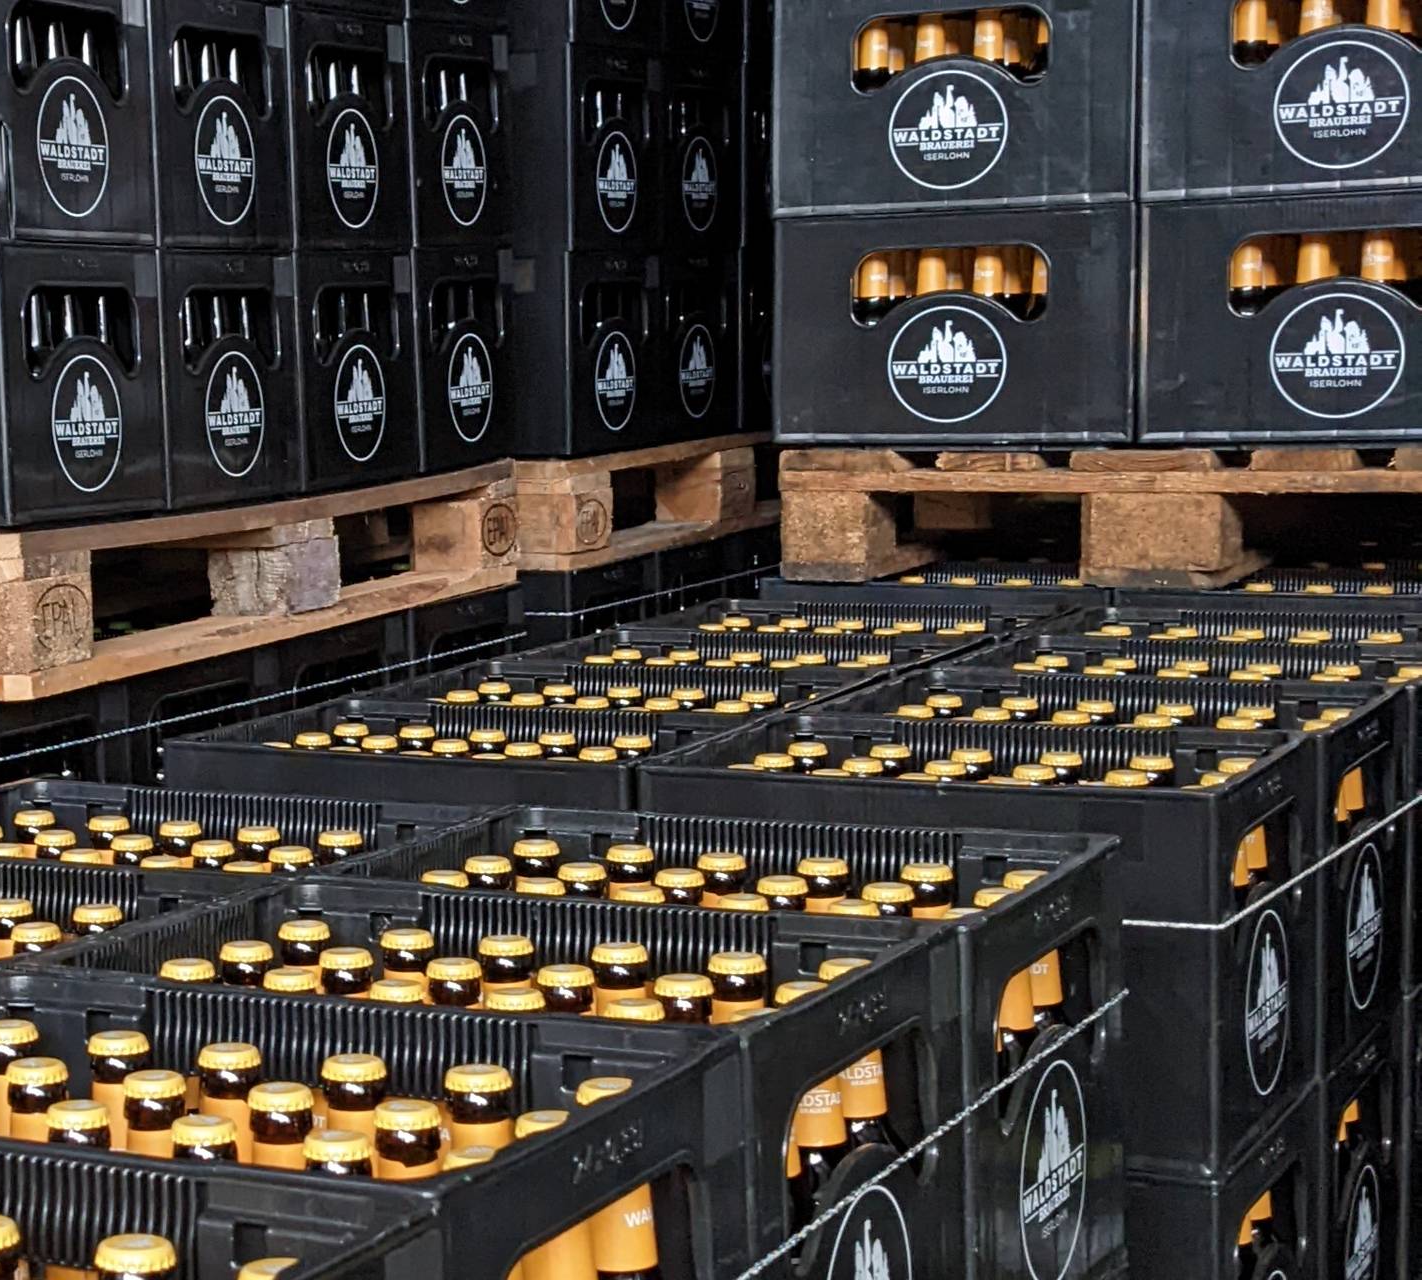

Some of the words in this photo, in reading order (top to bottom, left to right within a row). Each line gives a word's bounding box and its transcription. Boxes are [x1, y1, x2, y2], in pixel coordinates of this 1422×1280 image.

[1279, 100, 1399, 119] WALDSTADT
[1308, 114, 1372, 127] BRAUEREI
[893, 127, 1000, 143] WALDSTADT
[1314, 128, 1366, 139] ISERLOHN
[919, 139, 975, 151] BRAUEREI
[40, 143, 104, 161] WALDSTADT
[924, 152, 970, 161] ISERLOHN
[198, 159, 252, 174] WALDSTADT
[330, 167, 375, 179] WALDSTADT
[444, 169, 483, 180] WALDSTADT
[1276, 353, 1395, 368] WALDSTADT
[892, 363, 998, 375] WALDSTADT
[1304, 366, 1367, 376] BRAUEREI
[918, 374, 973, 384] BRAUEREI
[1309, 378, 1362, 387] ISERLOHN
[450, 384, 490, 399] WALDSTADT
[923, 386, 969, 394] ISERLOHN
[338, 400, 382, 415] WALDSTADT
[208, 411, 260, 427] WALDSTADT
[55, 421, 118, 436] WALDSTADT
[1023, 1151, 1083, 1217] WALDSTADT
